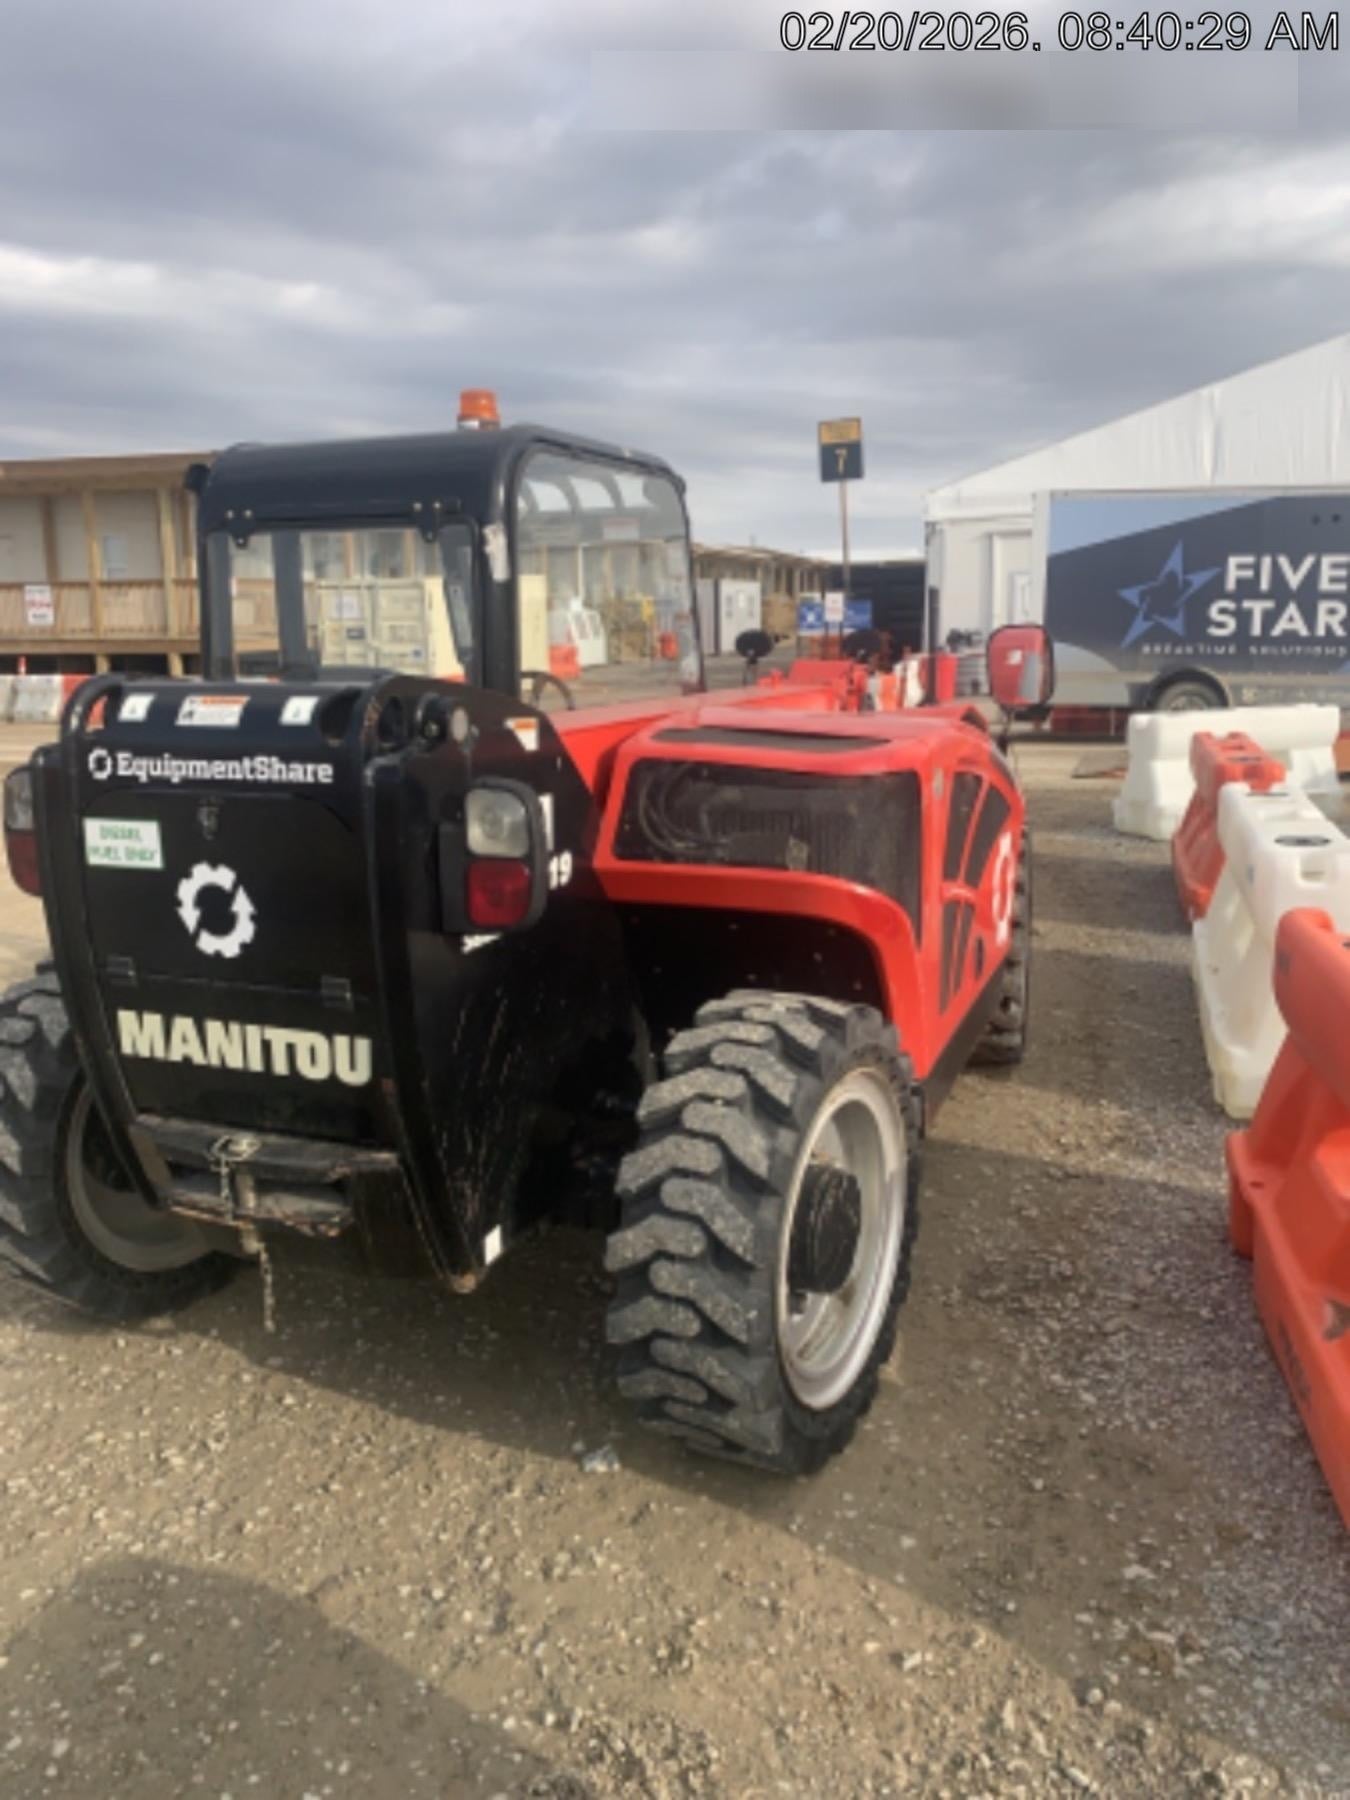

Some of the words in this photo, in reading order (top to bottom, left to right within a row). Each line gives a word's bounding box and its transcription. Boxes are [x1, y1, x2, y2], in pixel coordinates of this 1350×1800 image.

[1225, 553, 1350, 593] FIVE
[1206, 599, 1348, 637] STAR
[116, 752, 334, 784] EquipmentShare
[117, 1008, 373, 1087] MANITOU
